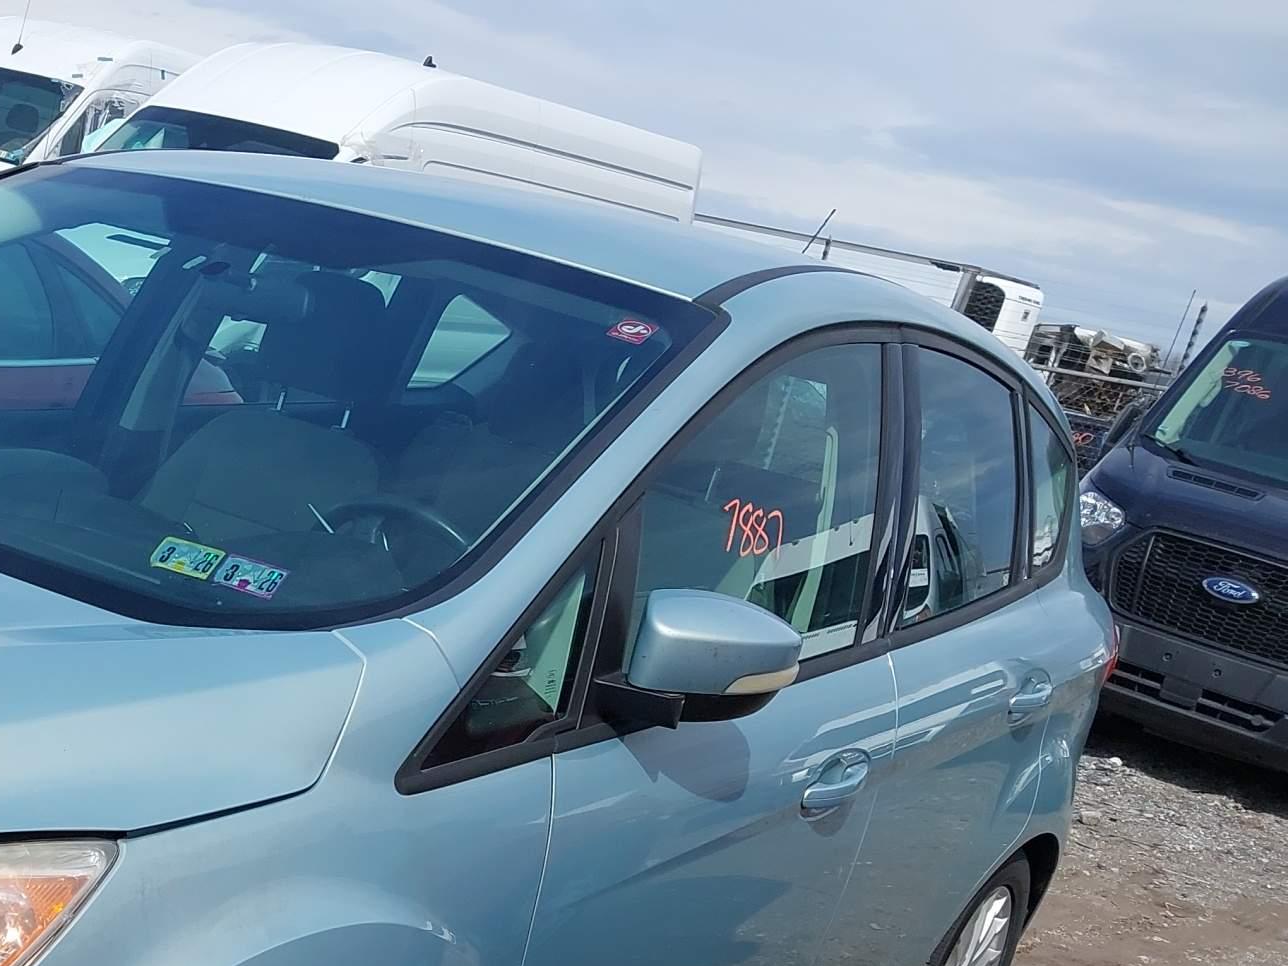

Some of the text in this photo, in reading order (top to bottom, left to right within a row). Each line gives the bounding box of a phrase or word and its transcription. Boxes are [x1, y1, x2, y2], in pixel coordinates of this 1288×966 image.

[723, 498, 783, 560] 7887
[159, 546, 219, 573] 3 26
[223, 564, 283, 592] 3 26
[1213, 581, 1247, 598] Ford
